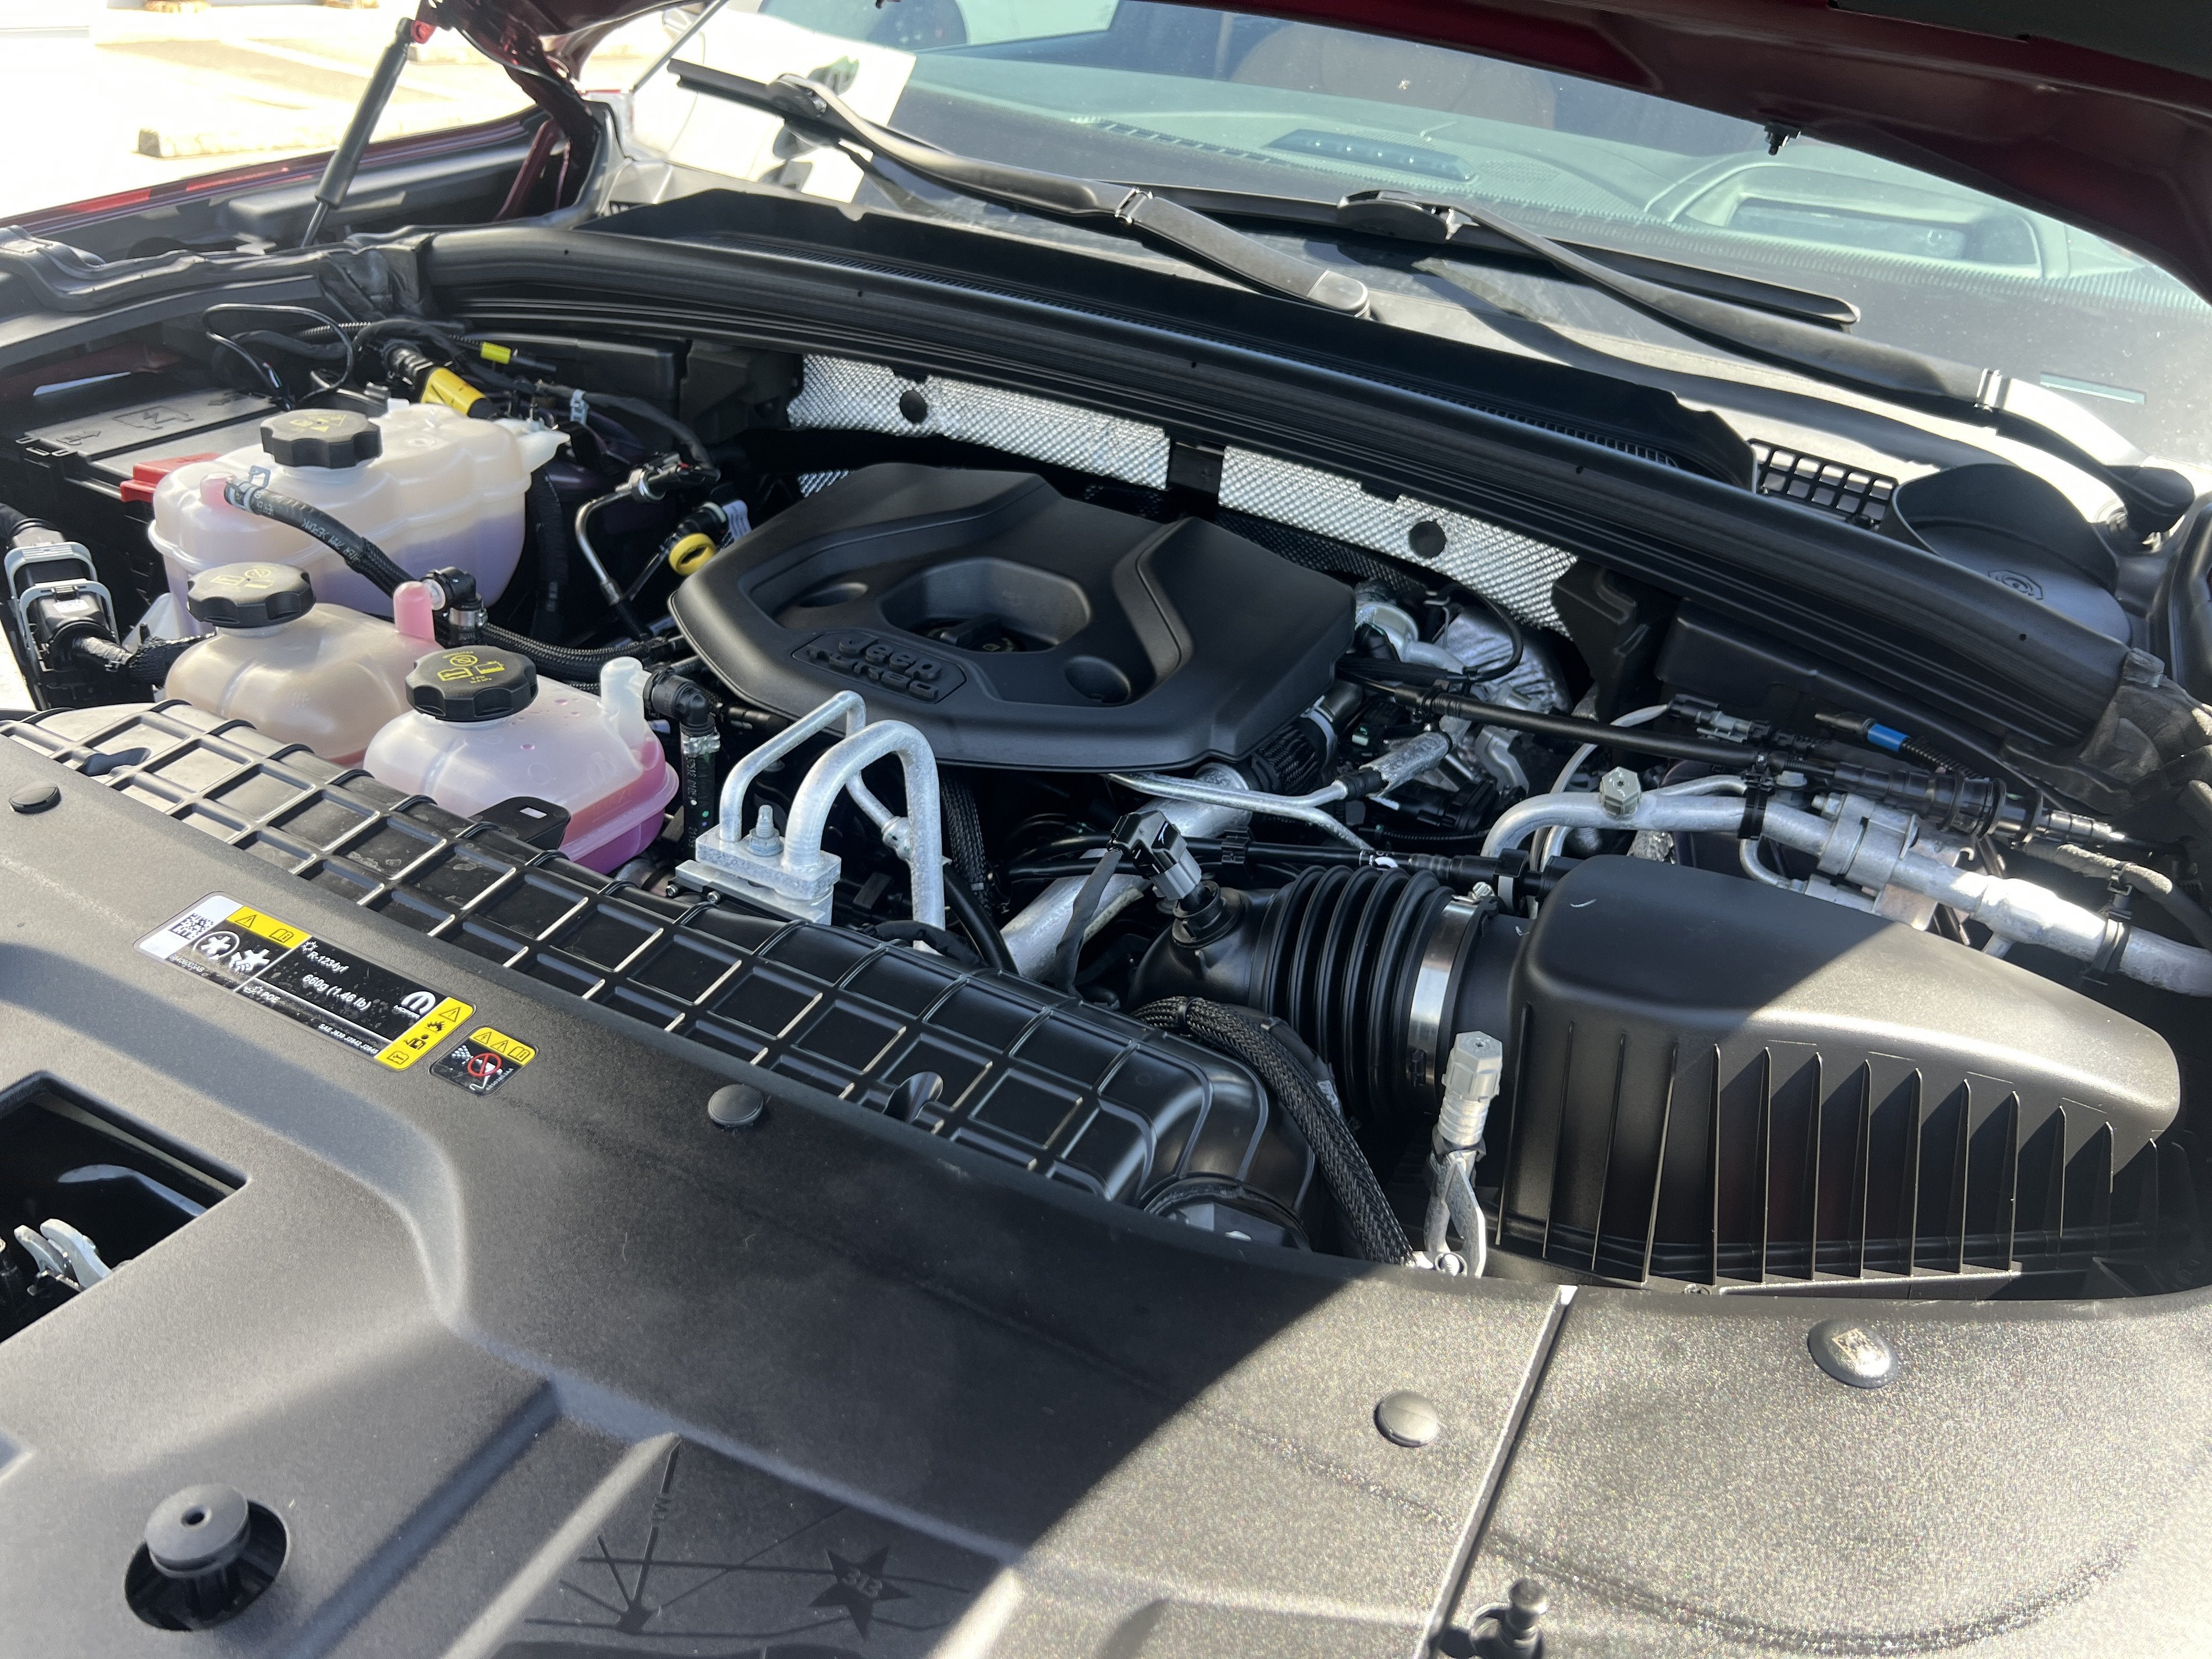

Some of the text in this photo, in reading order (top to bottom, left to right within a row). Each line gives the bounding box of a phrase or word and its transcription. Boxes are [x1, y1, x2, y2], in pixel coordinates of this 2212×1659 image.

[806, 644, 939, 699] TURBO
[838, 634, 942, 680] Jeep
[308, 950, 349, 974] R-1234yf
[259, 990, 281, 1005] POE
[302, 974, 372, 1012] 660g (1.46 lb)
[318, 1023, 332, 1032] SAE
